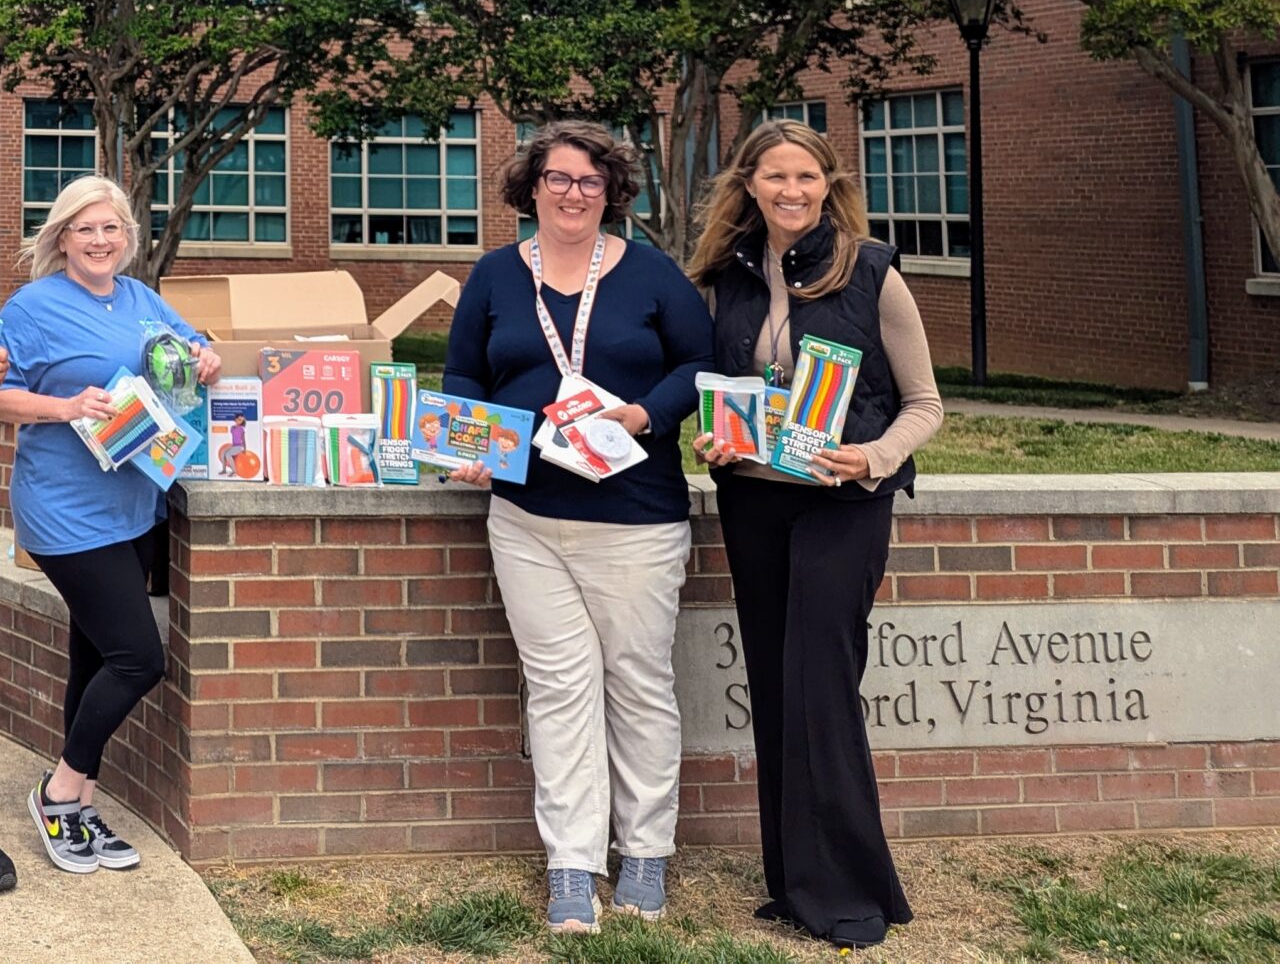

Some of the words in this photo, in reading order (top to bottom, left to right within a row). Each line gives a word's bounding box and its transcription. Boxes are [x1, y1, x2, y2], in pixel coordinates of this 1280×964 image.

[267, 356, 281, 373] 3
[837, 356, 853, 365] PACK
[283, 388, 344, 414] 300
[451, 420, 489, 438] SHAPE
[788, 421, 833, 442] SENSORY
[454, 433, 489, 447] COLOR
[782, 436, 821, 454] STRETC
[791, 431, 826, 448] FIDGET
[382, 446, 410, 454] FIDGET
[783, 445, 813, 460] STRIN
[380, 460, 414, 468] STRINGS
[986, 620, 1153, 666] Avenue
[939, 677, 1150, 735] Virginia
